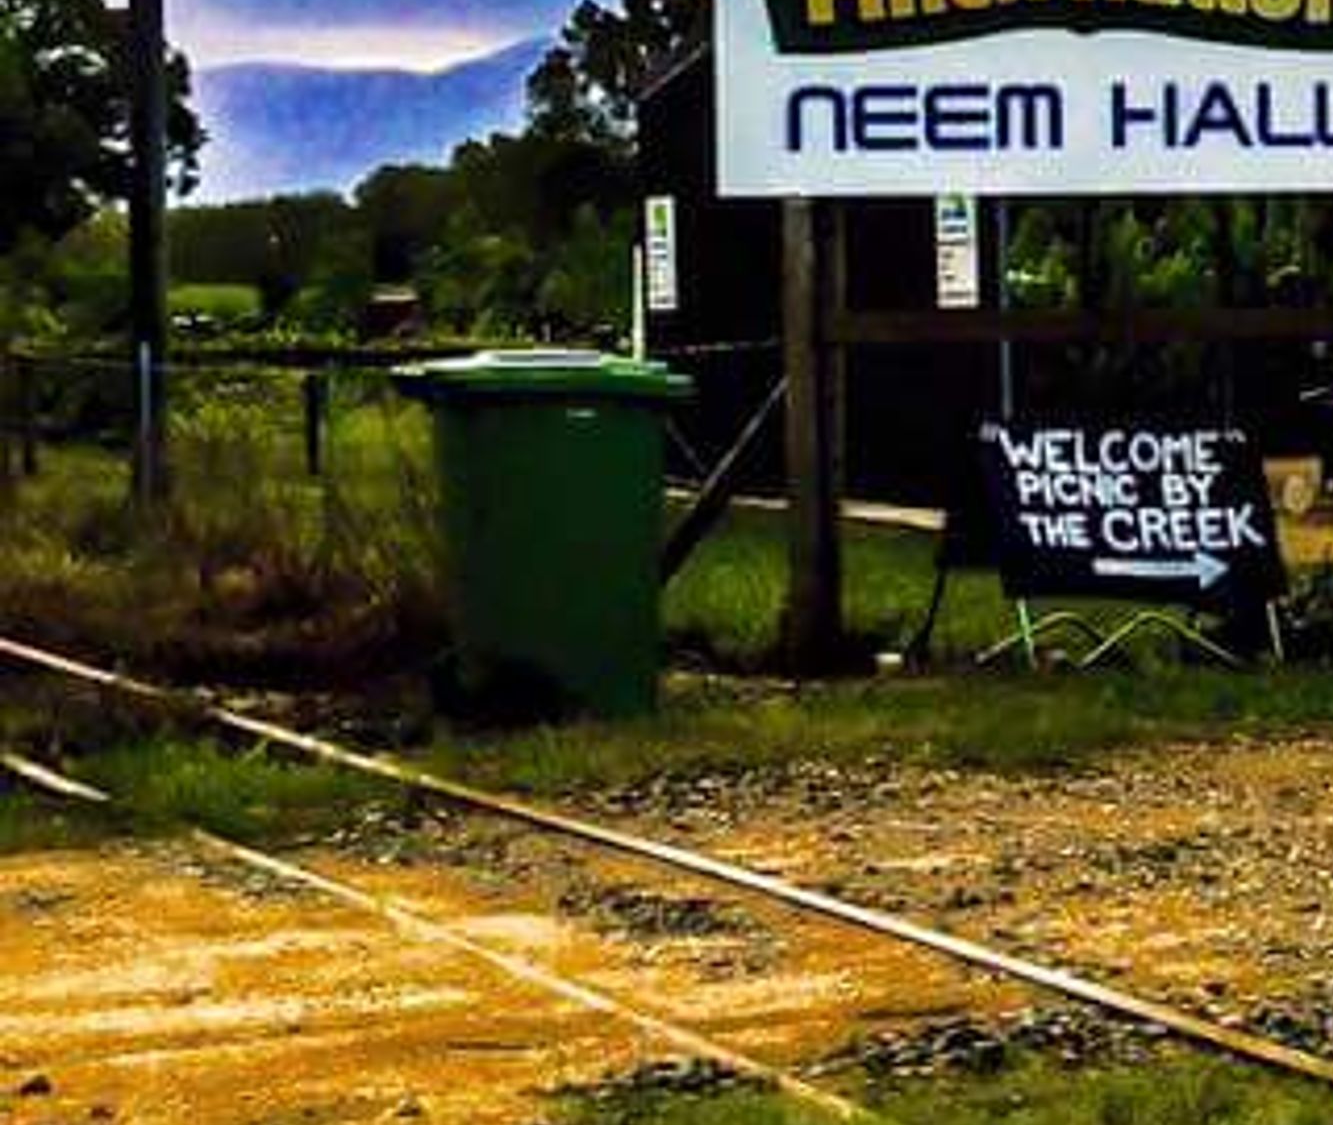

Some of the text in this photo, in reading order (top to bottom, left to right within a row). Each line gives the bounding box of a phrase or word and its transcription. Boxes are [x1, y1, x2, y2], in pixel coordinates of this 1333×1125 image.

[787, 82, 1062, 151] NEEM
[1016, 470, 1215, 507] PICNIC BY
[1018, 503, 1267, 552] THE CREEK
